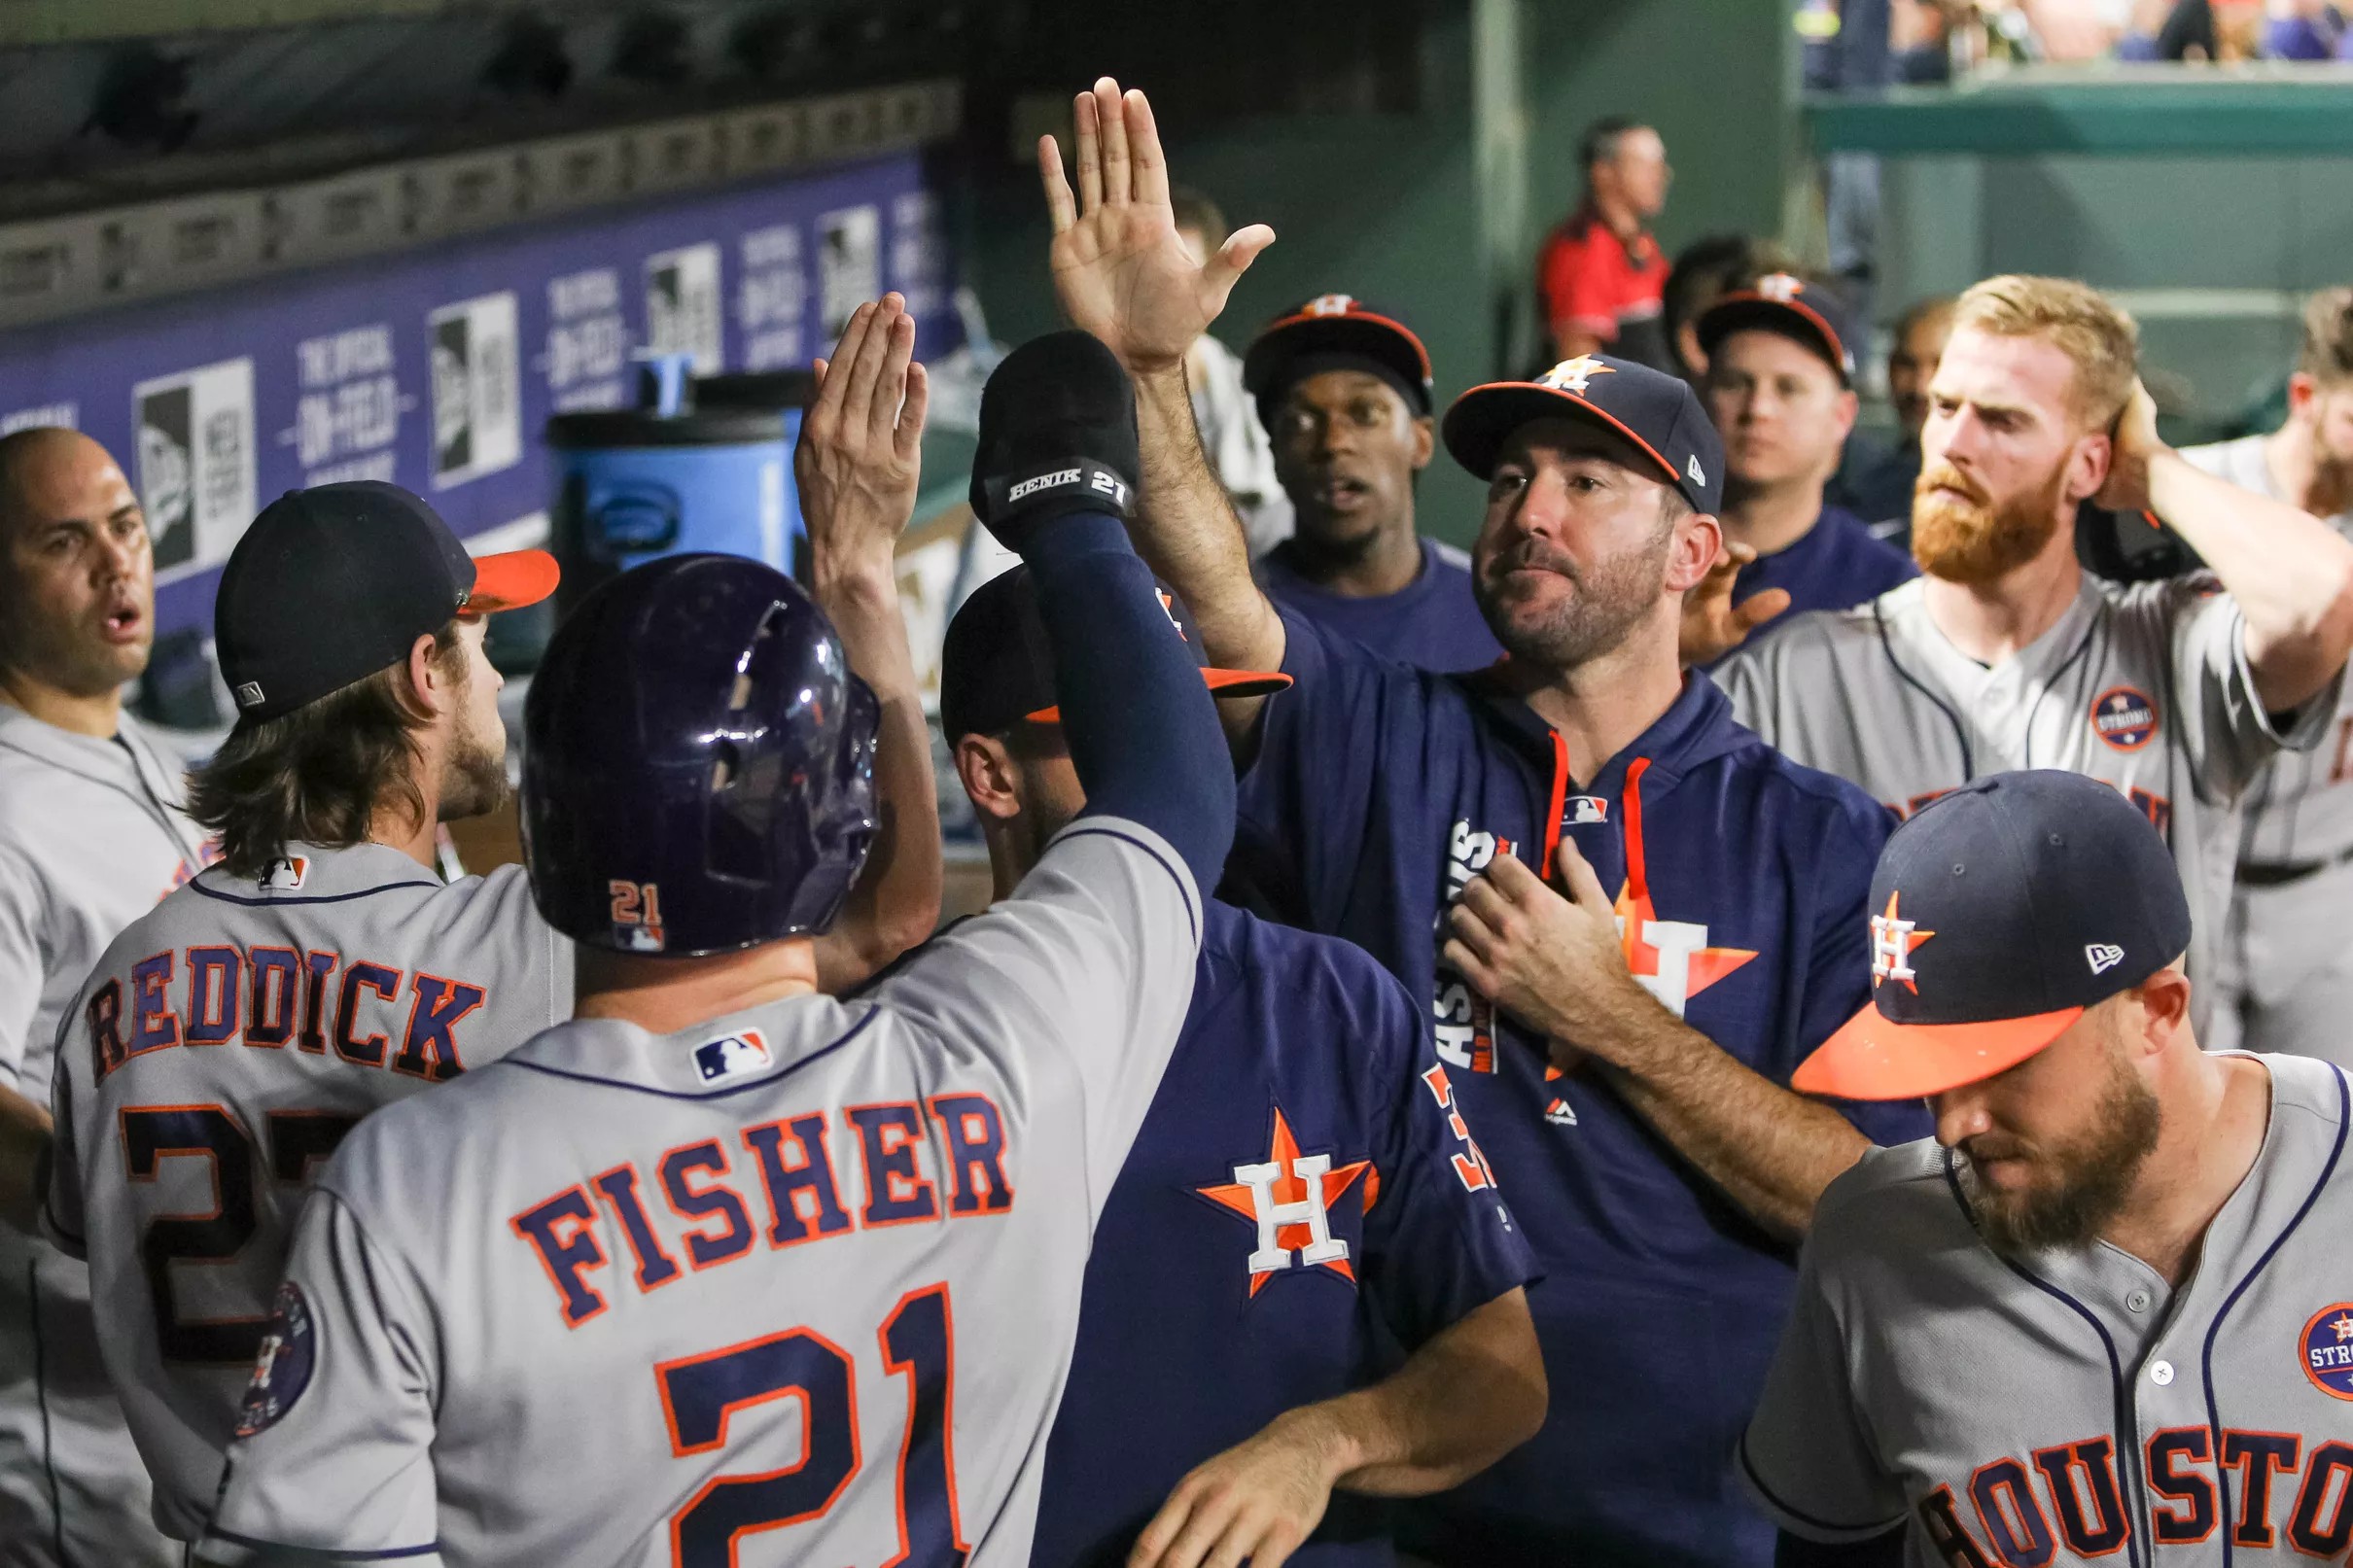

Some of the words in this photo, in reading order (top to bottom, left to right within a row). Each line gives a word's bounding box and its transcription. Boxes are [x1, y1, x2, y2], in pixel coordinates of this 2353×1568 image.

[1009, 468, 1081, 503] BENIK
[1091, 470, 1126, 504] 21
[609, 880, 662, 925] 21
[1871, 915, 1916, 982] H
[87, 944, 487, 1088] REDDICK
[509, 1091, 1015, 1330] FISHER
[1234, 1154, 1350, 1274] H
[2310, 1344, 2353, 1368] STR
[652, 1280, 973, 1568] 21
[1918, 1424, 2353, 1568] HOUSTO
